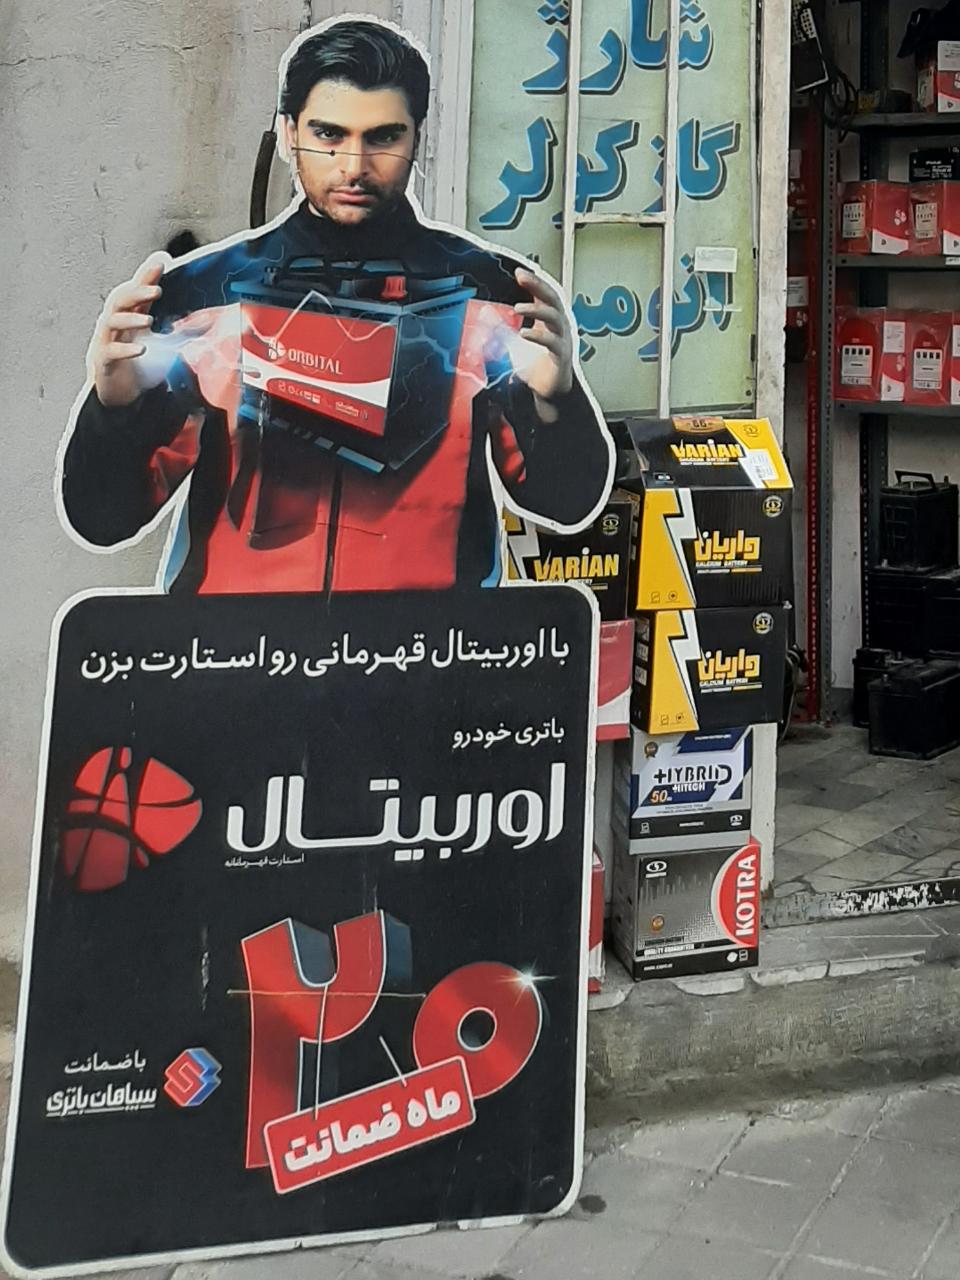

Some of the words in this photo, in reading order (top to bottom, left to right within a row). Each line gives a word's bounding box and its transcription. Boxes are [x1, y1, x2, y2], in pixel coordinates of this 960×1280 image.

[479, 116, 640, 231] کولر
[640, 117, 741, 229] گاز
[288, 348, 344, 375] ORBITAL
[670, 439, 744, 458] VARIAN
[694, 526, 760, 560] واریان
[533, 547, 620, 580] VARIAN
[139, 635, 267, 680] استارت
[302, 632, 426, 677] قهرمانی
[431, 627, 545, 668] اوربیتال
[550, 626, 570, 666] با
[80, 650, 134, 684] بزن
[267, 650, 297, 677] رو
[697, 648, 760, 681] واریان
[451, 722, 512, 749] خودرو
[514, 717, 565, 746] باتری
[226, 762, 567, 861] اوربیتال
[650, 789, 669, 803] 50
[735, 854, 757, 937] KOTRA
[63, 1051, 134, 1074] ضمانت
[134, 1048, 147, 1073] با
[45, 1084, 89, 1118] باتری
[89, 1081, 158, 1112] سپاهان
[406, 1086, 462, 1128] ماه
[283, 1100, 402, 1172] ضمانت
